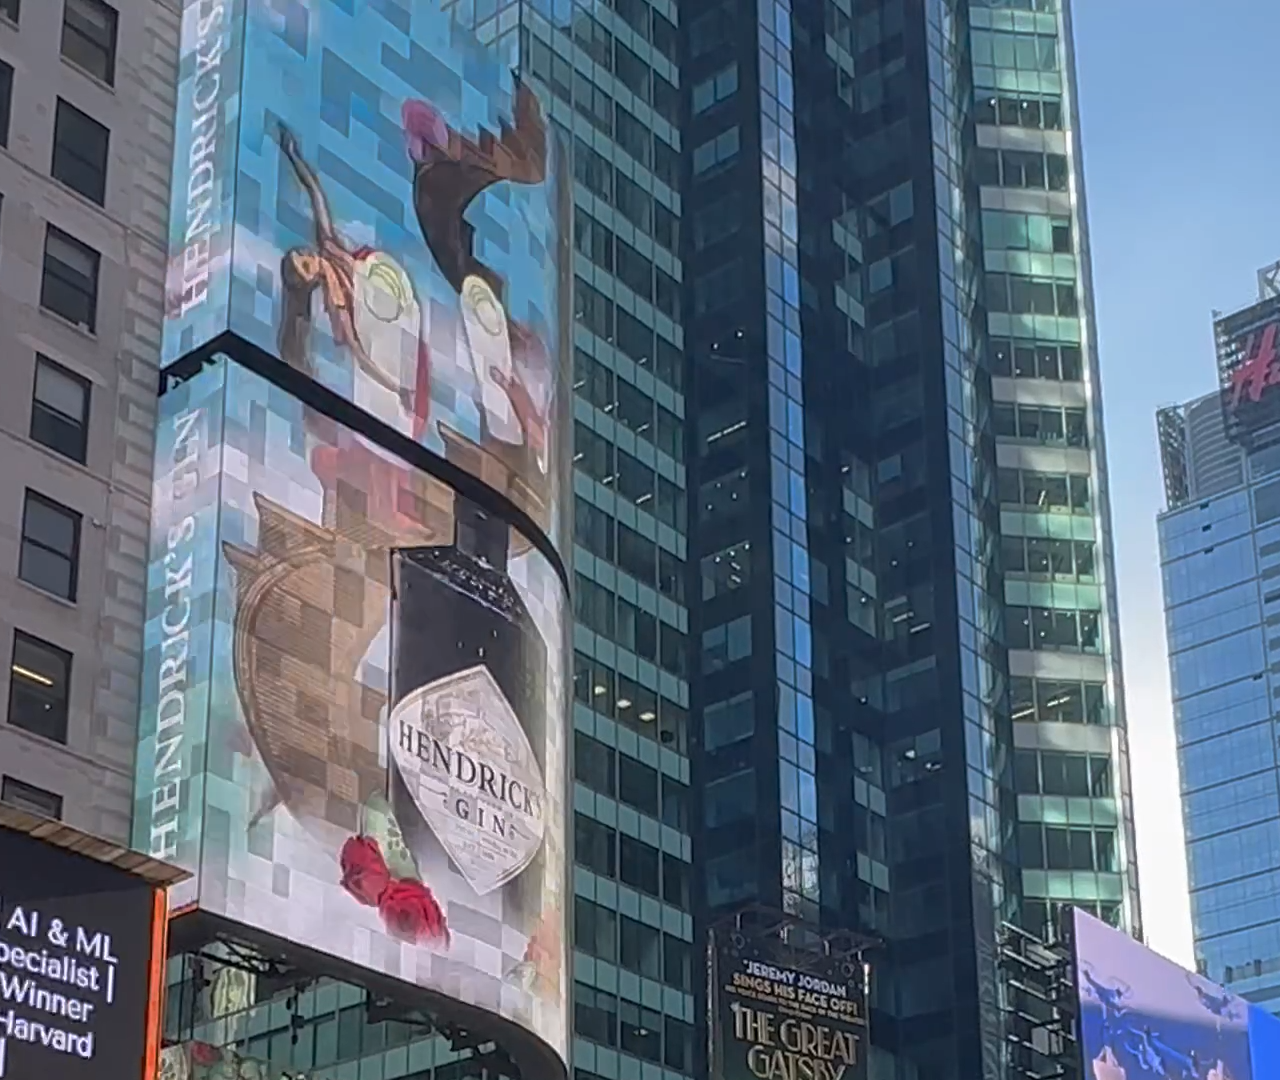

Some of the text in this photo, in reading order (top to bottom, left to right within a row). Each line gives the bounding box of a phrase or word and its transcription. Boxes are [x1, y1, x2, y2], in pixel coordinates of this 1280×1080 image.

[149, 516, 196, 861] HENDRICK'S
[455, 798, 507, 838] GIN
[6, 905, 38, 938] AI
[47, 919, 69, 948] &
[75, 926, 119, 964] ML
[733, 972, 771, 993] SINGS
[773, 982, 796, 999] HIS
[797, 989, 828, 1008] FACE
[798, 975, 847, 998] JORDAN
[730, 1002, 860, 1066] THE GREAT
